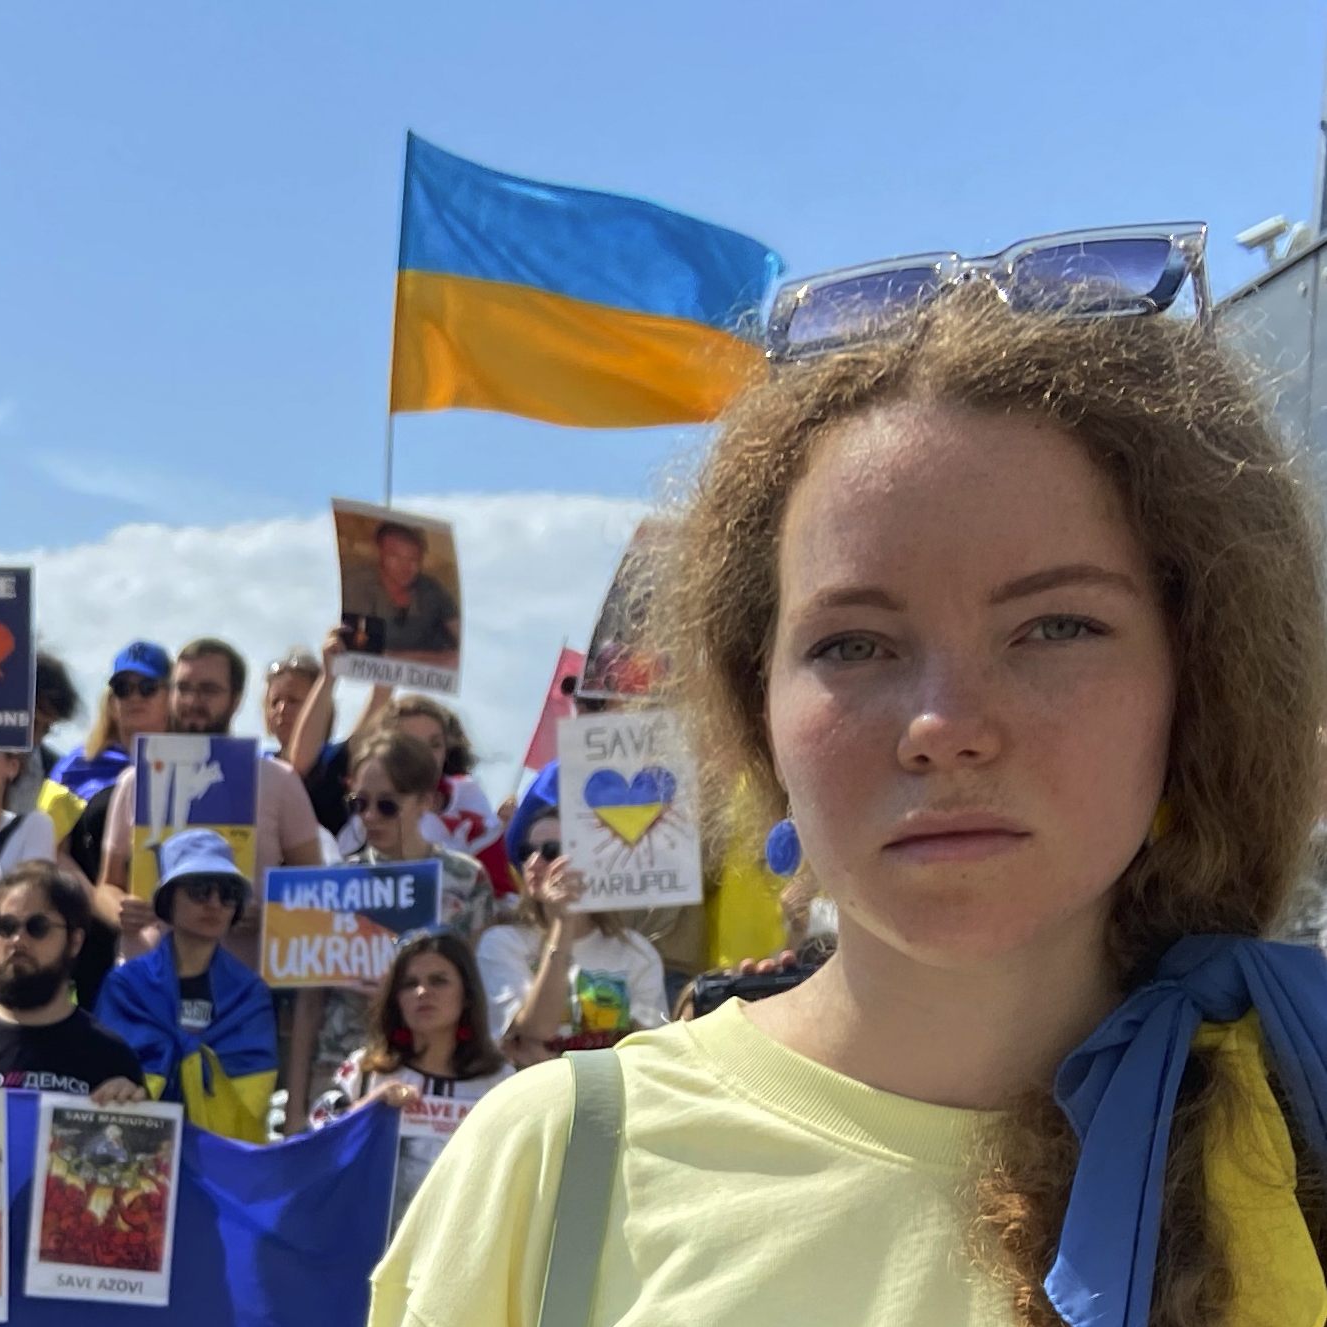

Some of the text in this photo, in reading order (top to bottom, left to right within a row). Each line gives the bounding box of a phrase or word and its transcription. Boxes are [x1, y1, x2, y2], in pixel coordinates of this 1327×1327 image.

[282, 874, 416, 912] UKRAINE
[587, 869, 690, 897] MARIUPOL
[333, 911, 360, 934] IS
